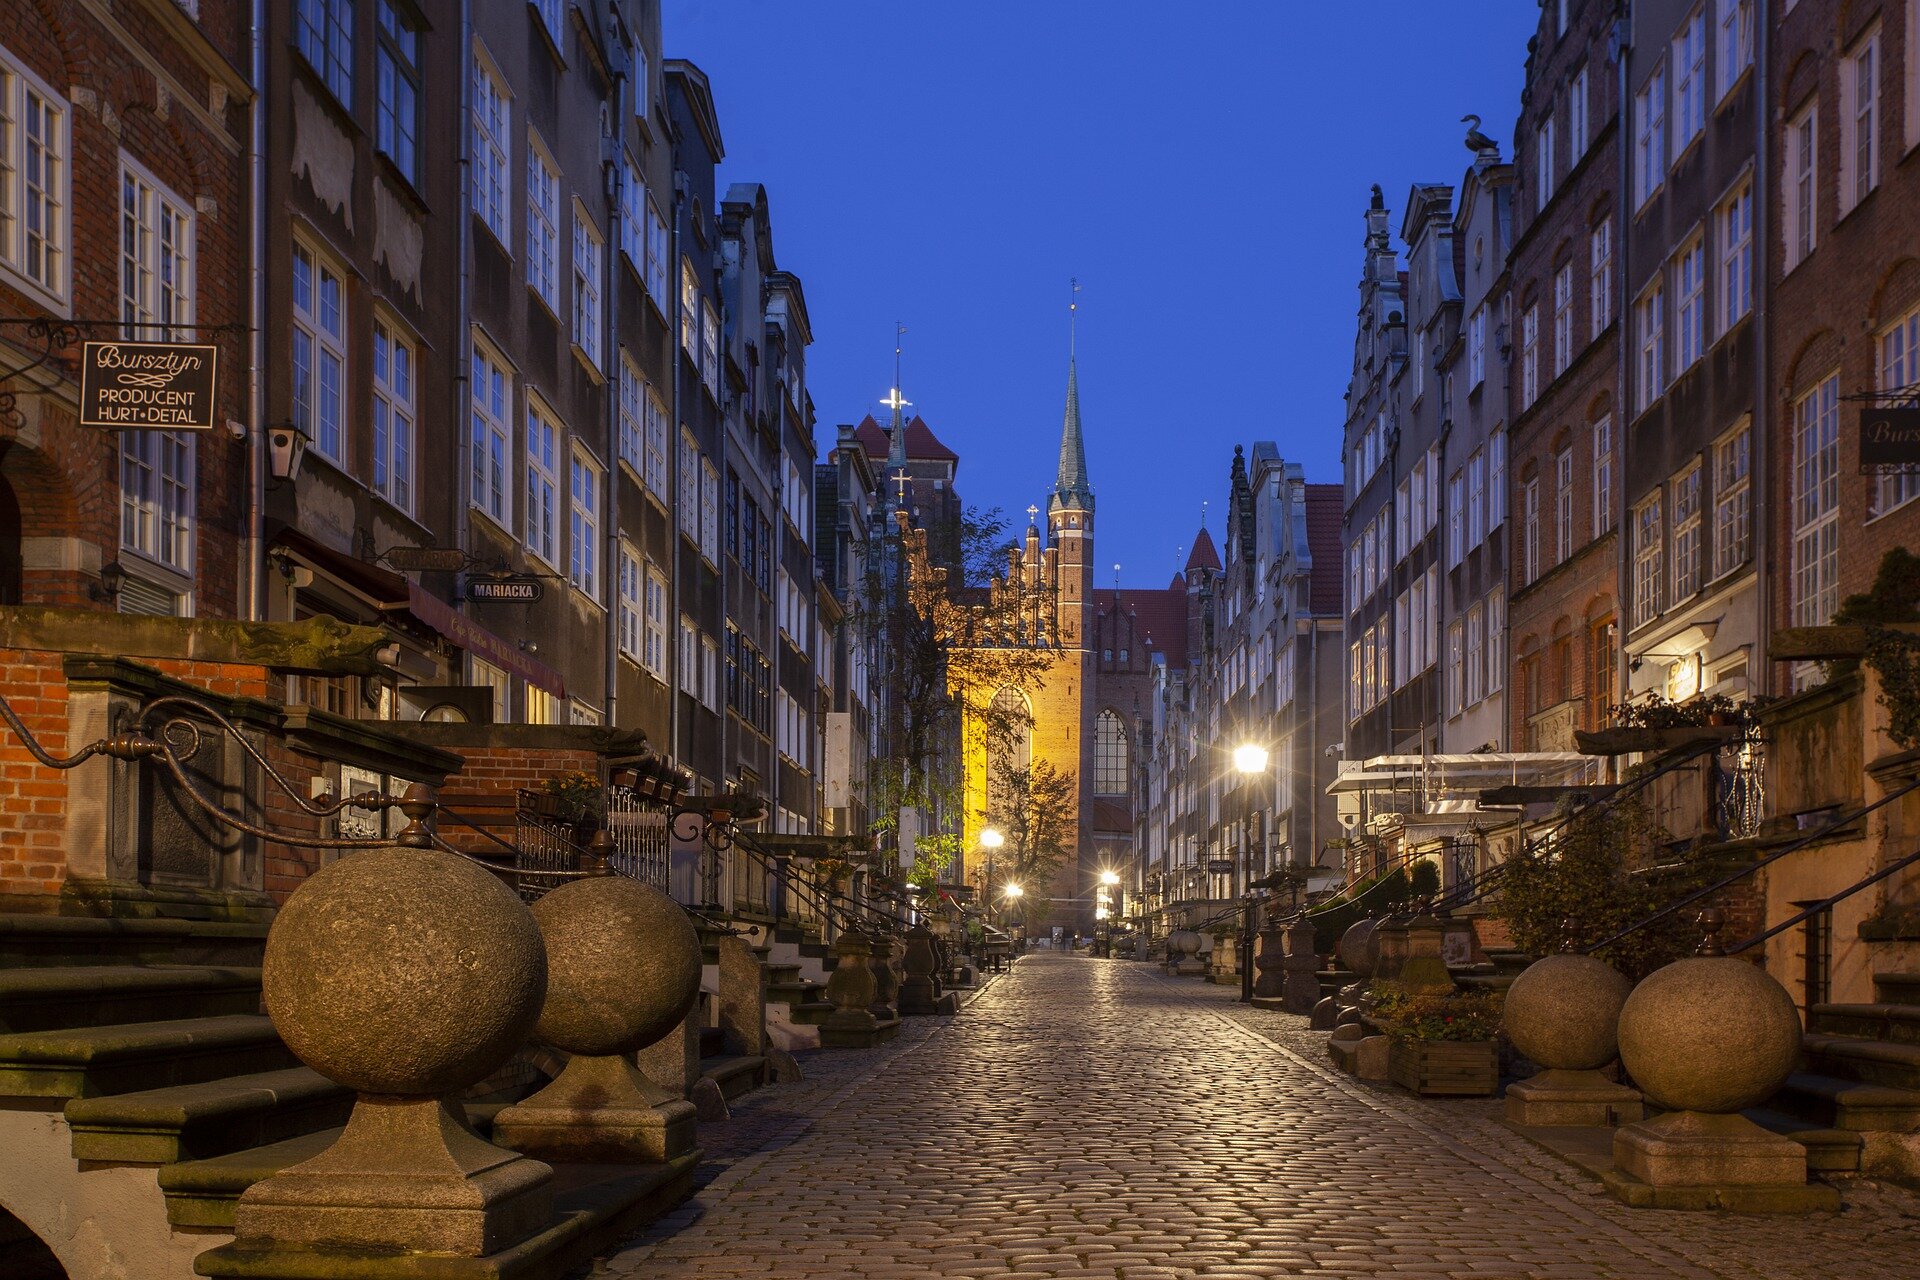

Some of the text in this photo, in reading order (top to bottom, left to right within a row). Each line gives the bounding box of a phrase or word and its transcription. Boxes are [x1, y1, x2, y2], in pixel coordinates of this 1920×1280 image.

[97, 345, 202, 375] Bursztyn
[99, 388, 196, 406] PRODUCENT
[474, 584, 533, 598] MARIACKA
